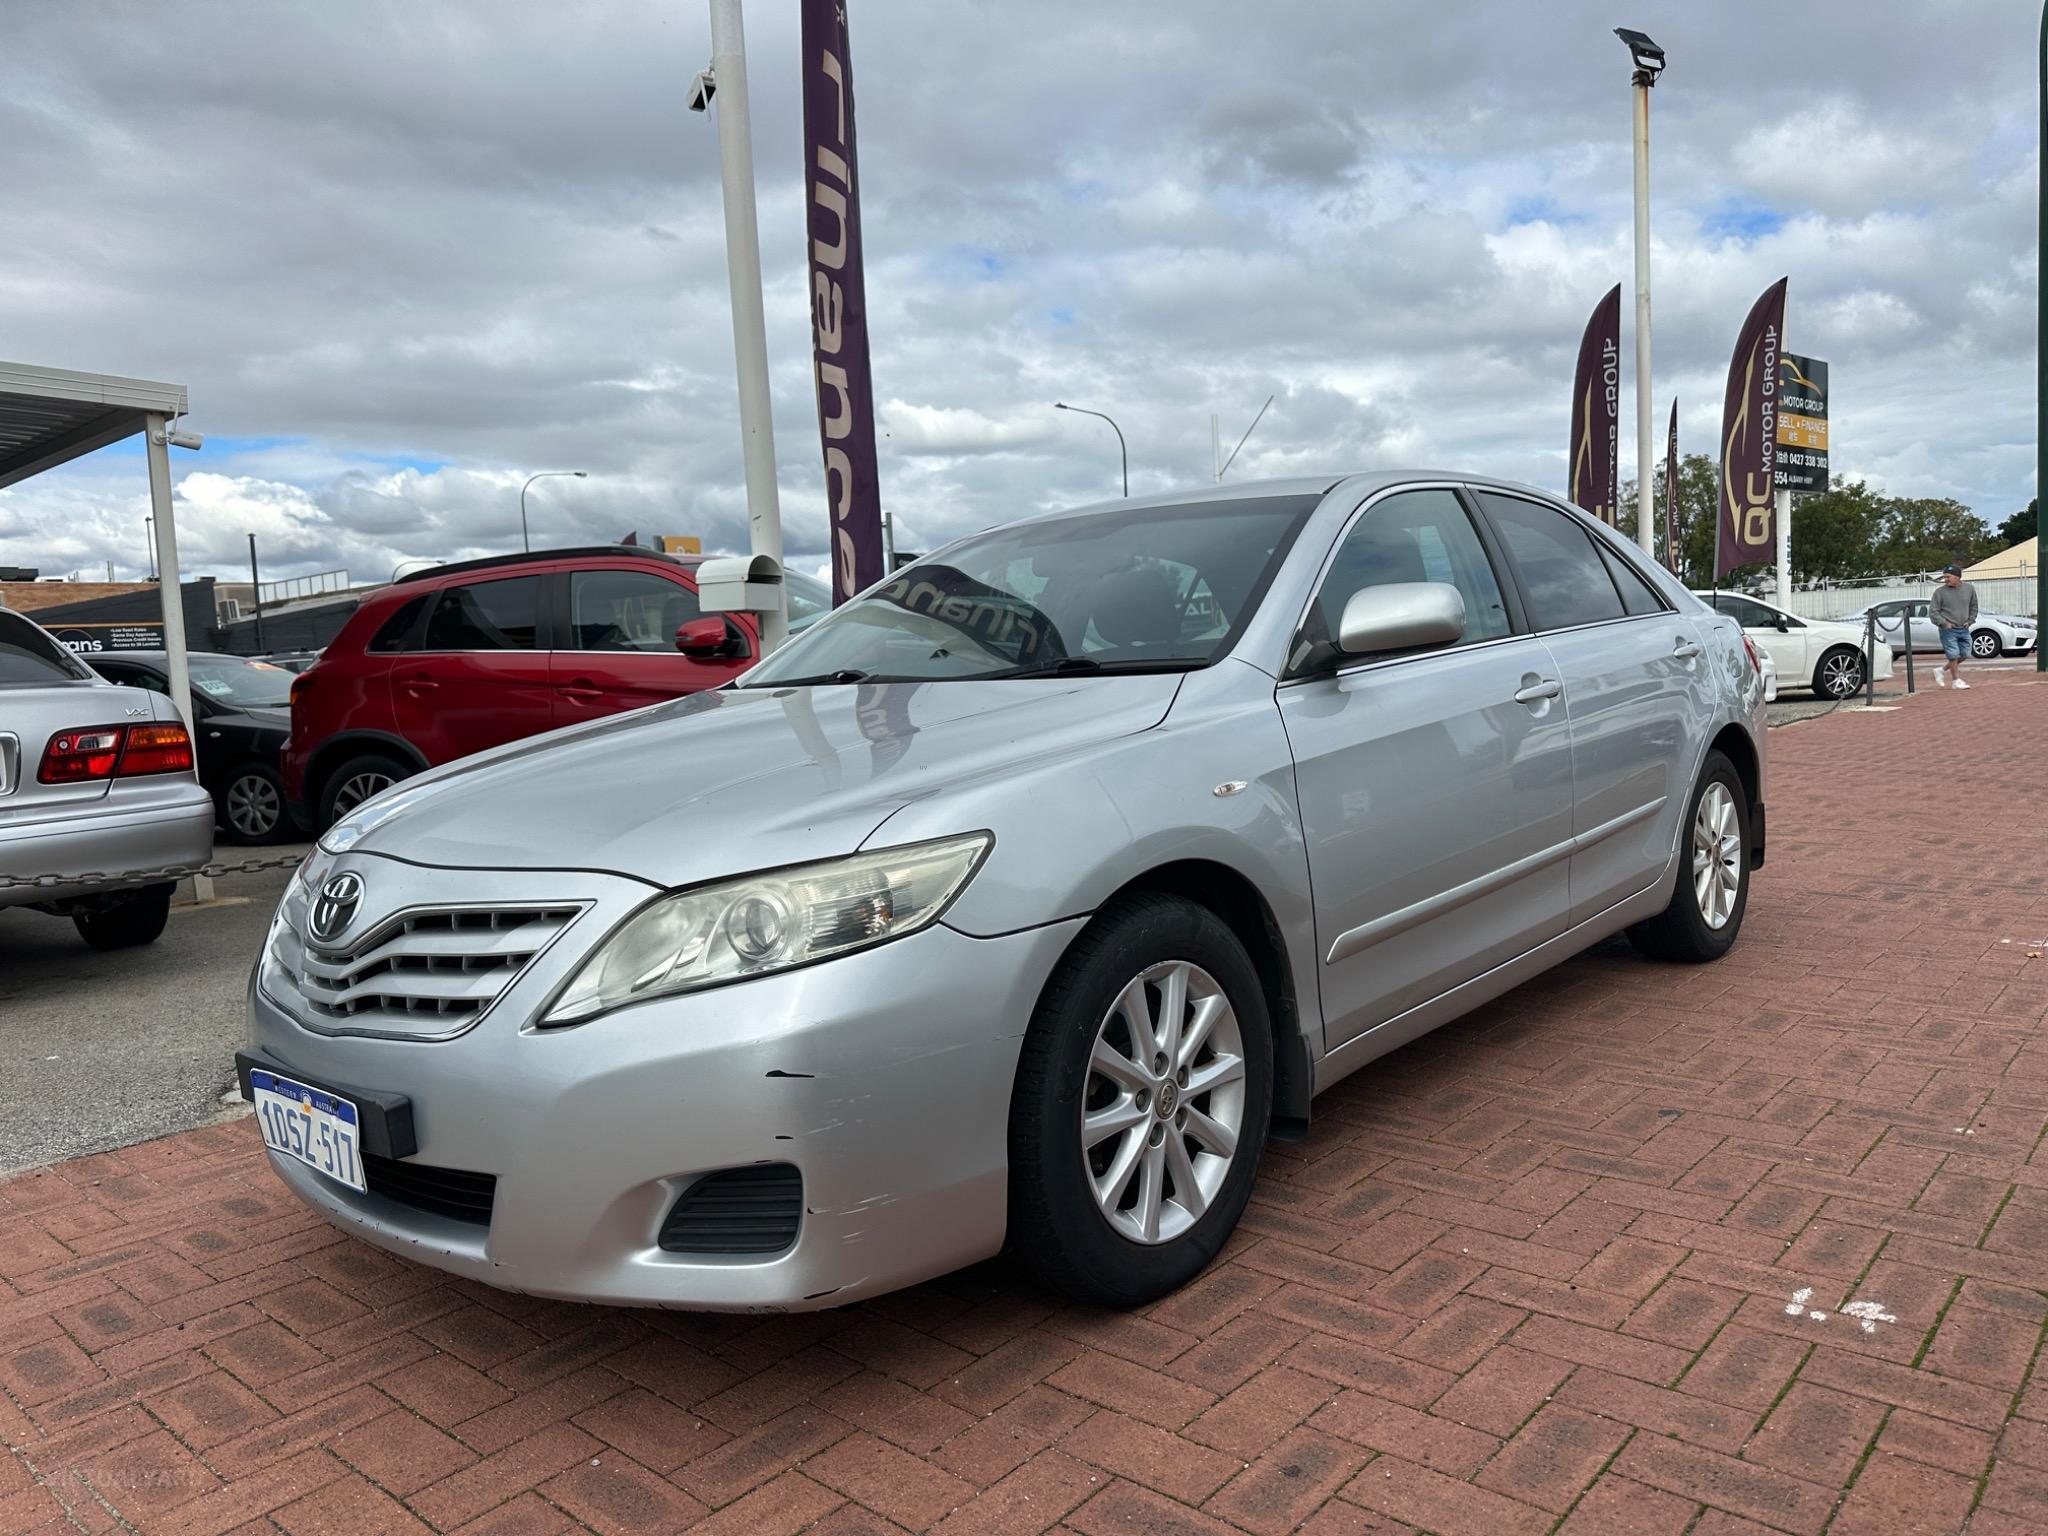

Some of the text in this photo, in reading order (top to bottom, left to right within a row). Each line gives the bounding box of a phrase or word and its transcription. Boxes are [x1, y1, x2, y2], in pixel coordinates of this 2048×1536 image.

[1603, 338, 1618, 418] GROUP
[1762, 325, 1778, 472] MOTOR GROUP
[1783, 394, 1824, 413] MOTOR GROUP
[1744, 472, 1771, 545] QC
[1774, 470, 1788, 485] 554
